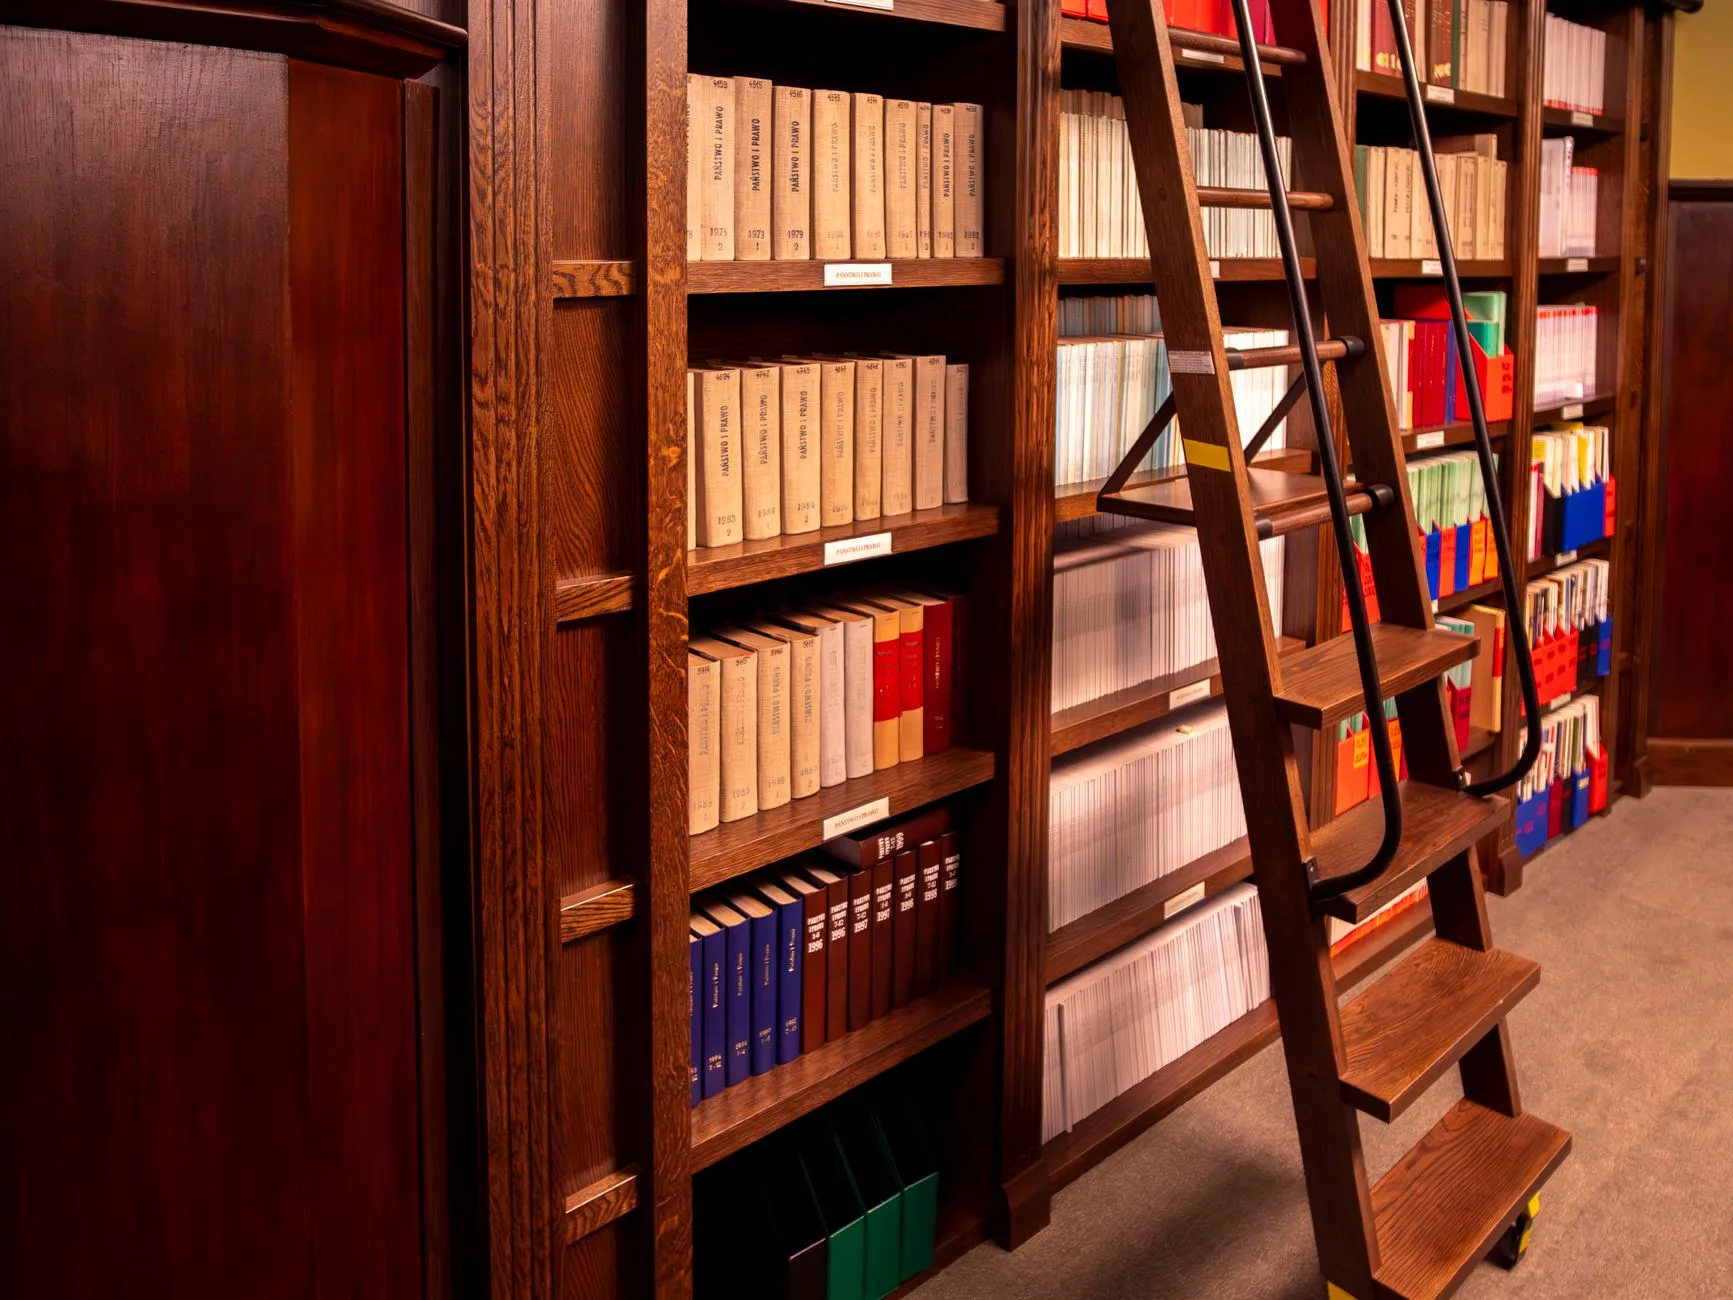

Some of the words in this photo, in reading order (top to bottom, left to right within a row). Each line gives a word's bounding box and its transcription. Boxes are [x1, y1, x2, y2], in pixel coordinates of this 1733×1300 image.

[715, 106, 724, 134] PRAWO
[752, 118, 760, 146] PRAWO
[791, 120, 800, 148] PRAWO
[749, 154, 760, 192] PAŃSTWO
[789, 156, 800, 192] PAŃSTWO
[760, 394, 768, 422] PRAWO
[800, 390, 808, 417] PRAWO
[720, 406, 728, 432] PRAWO
[798, 424, 808, 460] PAŃSTWO
[718, 441, 729, 476] PAŃSTWO
[808, 938, 824, 953] 1996
[831, 927, 846, 942] 1996
